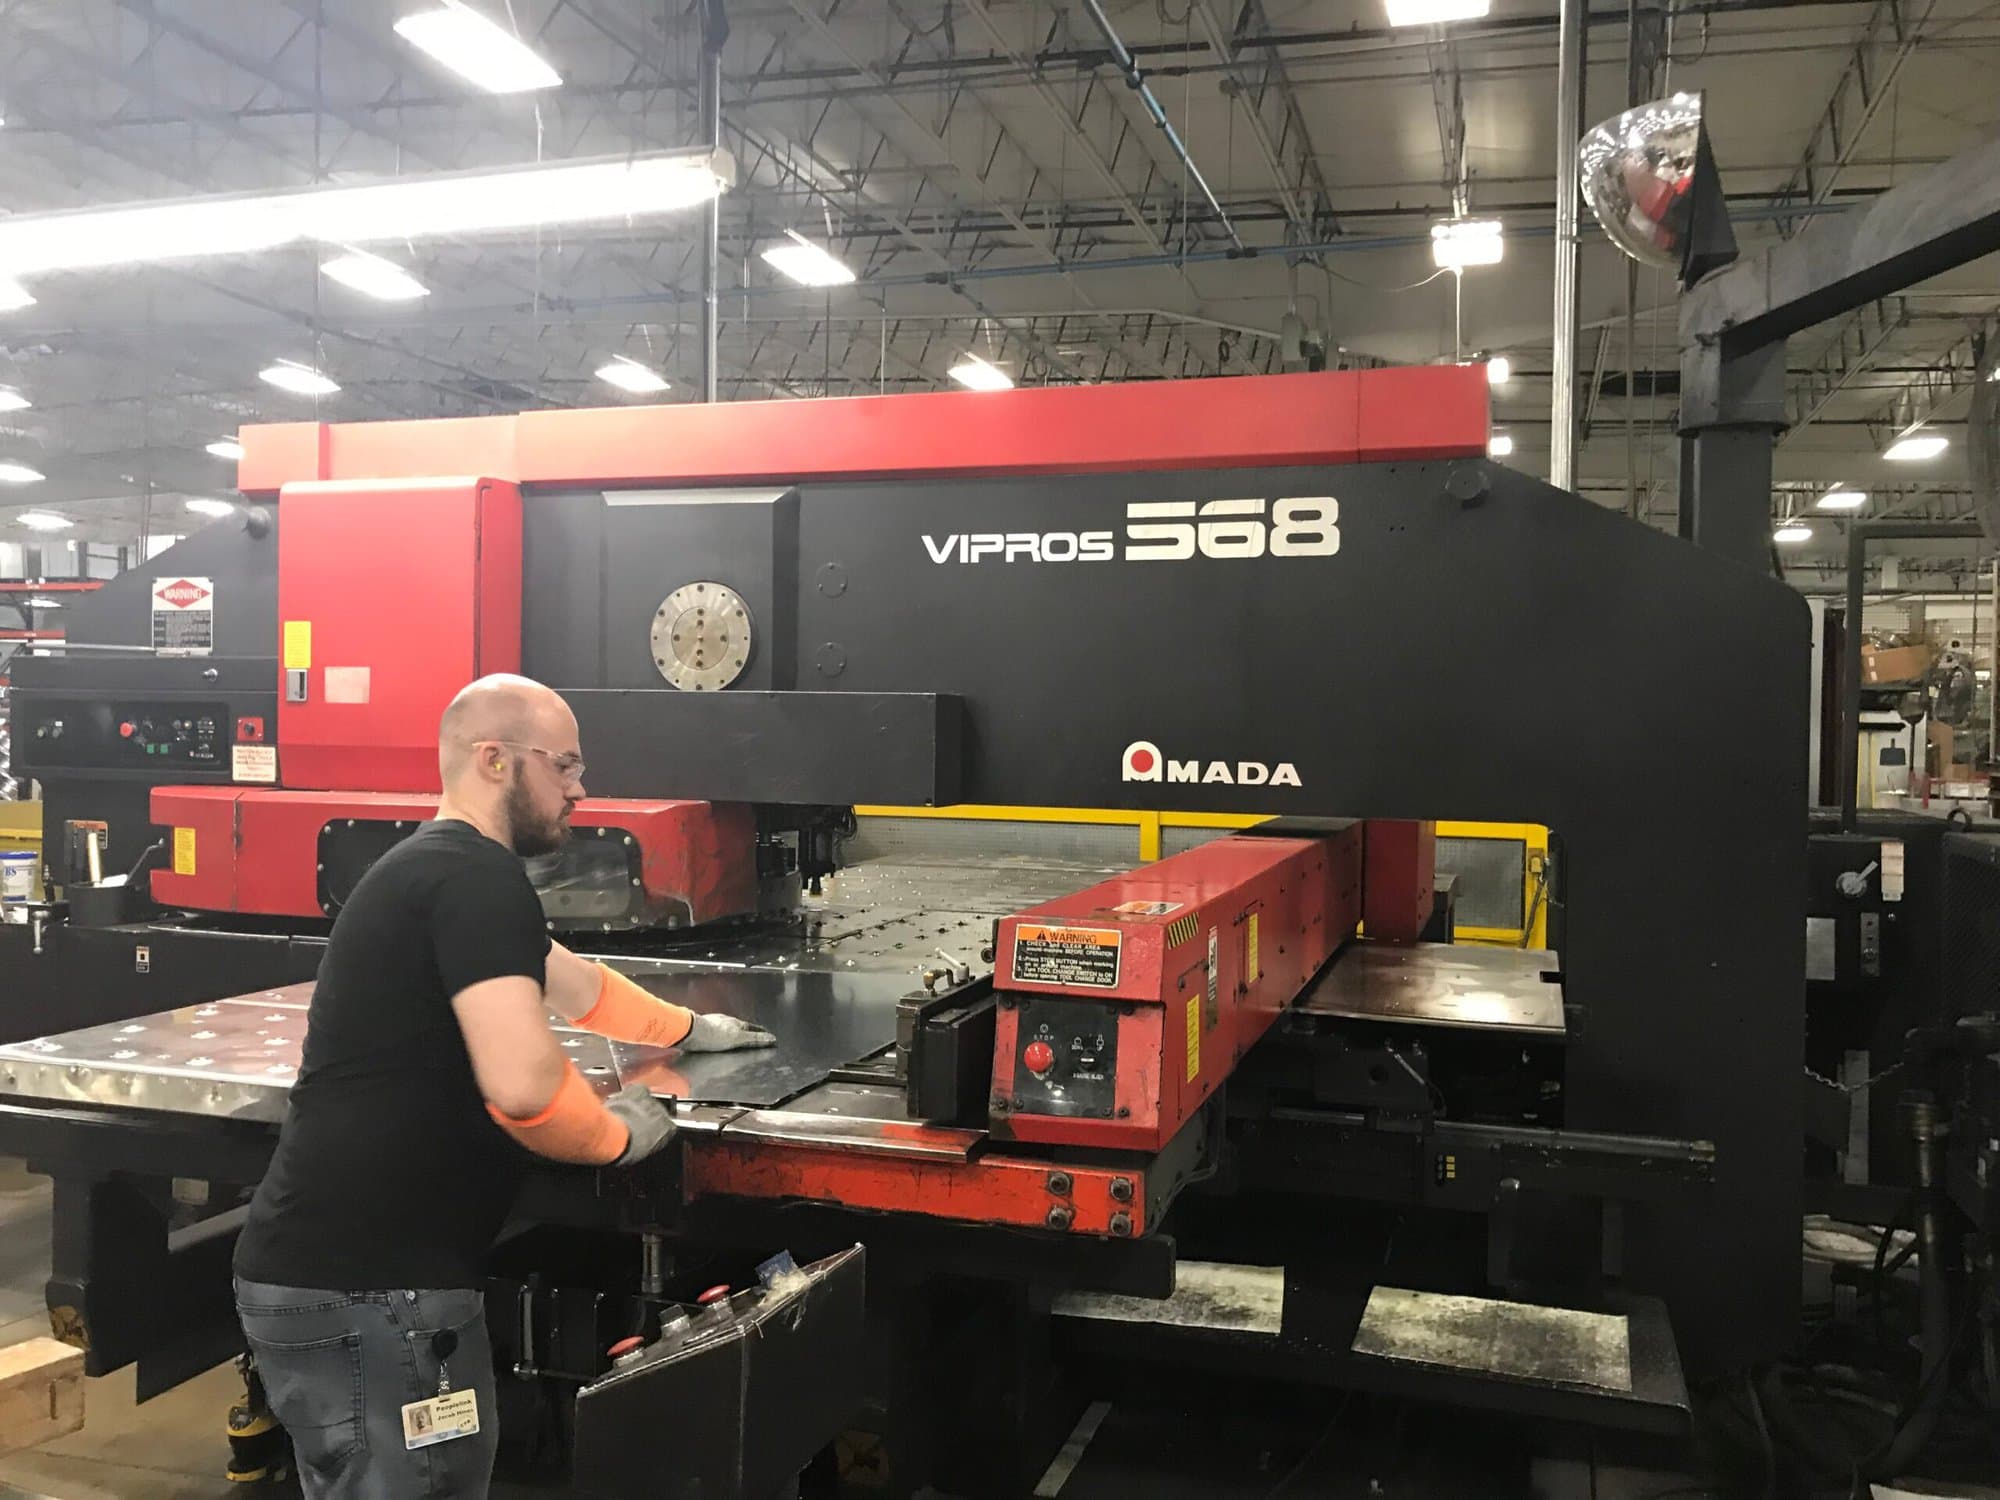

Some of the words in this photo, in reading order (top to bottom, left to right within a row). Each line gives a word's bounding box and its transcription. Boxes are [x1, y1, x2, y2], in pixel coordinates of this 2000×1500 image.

[921, 531, 1114, 564] VIPROS
[1125, 496, 1341, 561] 568
[164, 587, 202, 600] WARNING
[1122, 741, 1302, 787] AMADA
[1050, 932, 1097, 944] WARNING
[436, 1400, 472, 1411] Peoplelink
[438, 1412, 455, 1421] Jacob
